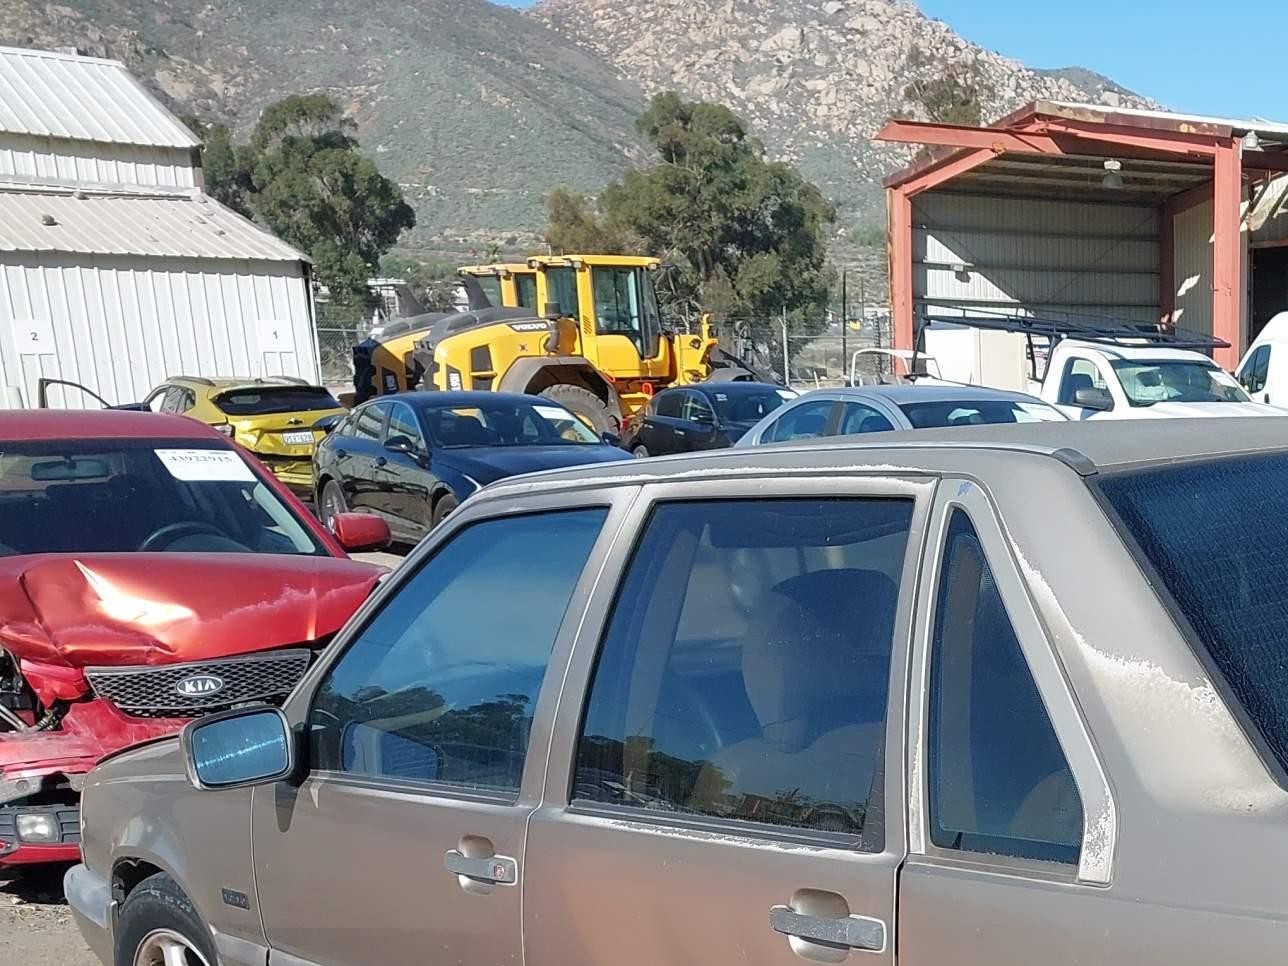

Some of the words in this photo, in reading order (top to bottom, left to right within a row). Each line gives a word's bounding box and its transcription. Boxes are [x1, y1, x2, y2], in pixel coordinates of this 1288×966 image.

[512, 323, 547, 331] VOLVO
[30, 331, 39, 341] 2
[184, 680, 217, 692] KIA
